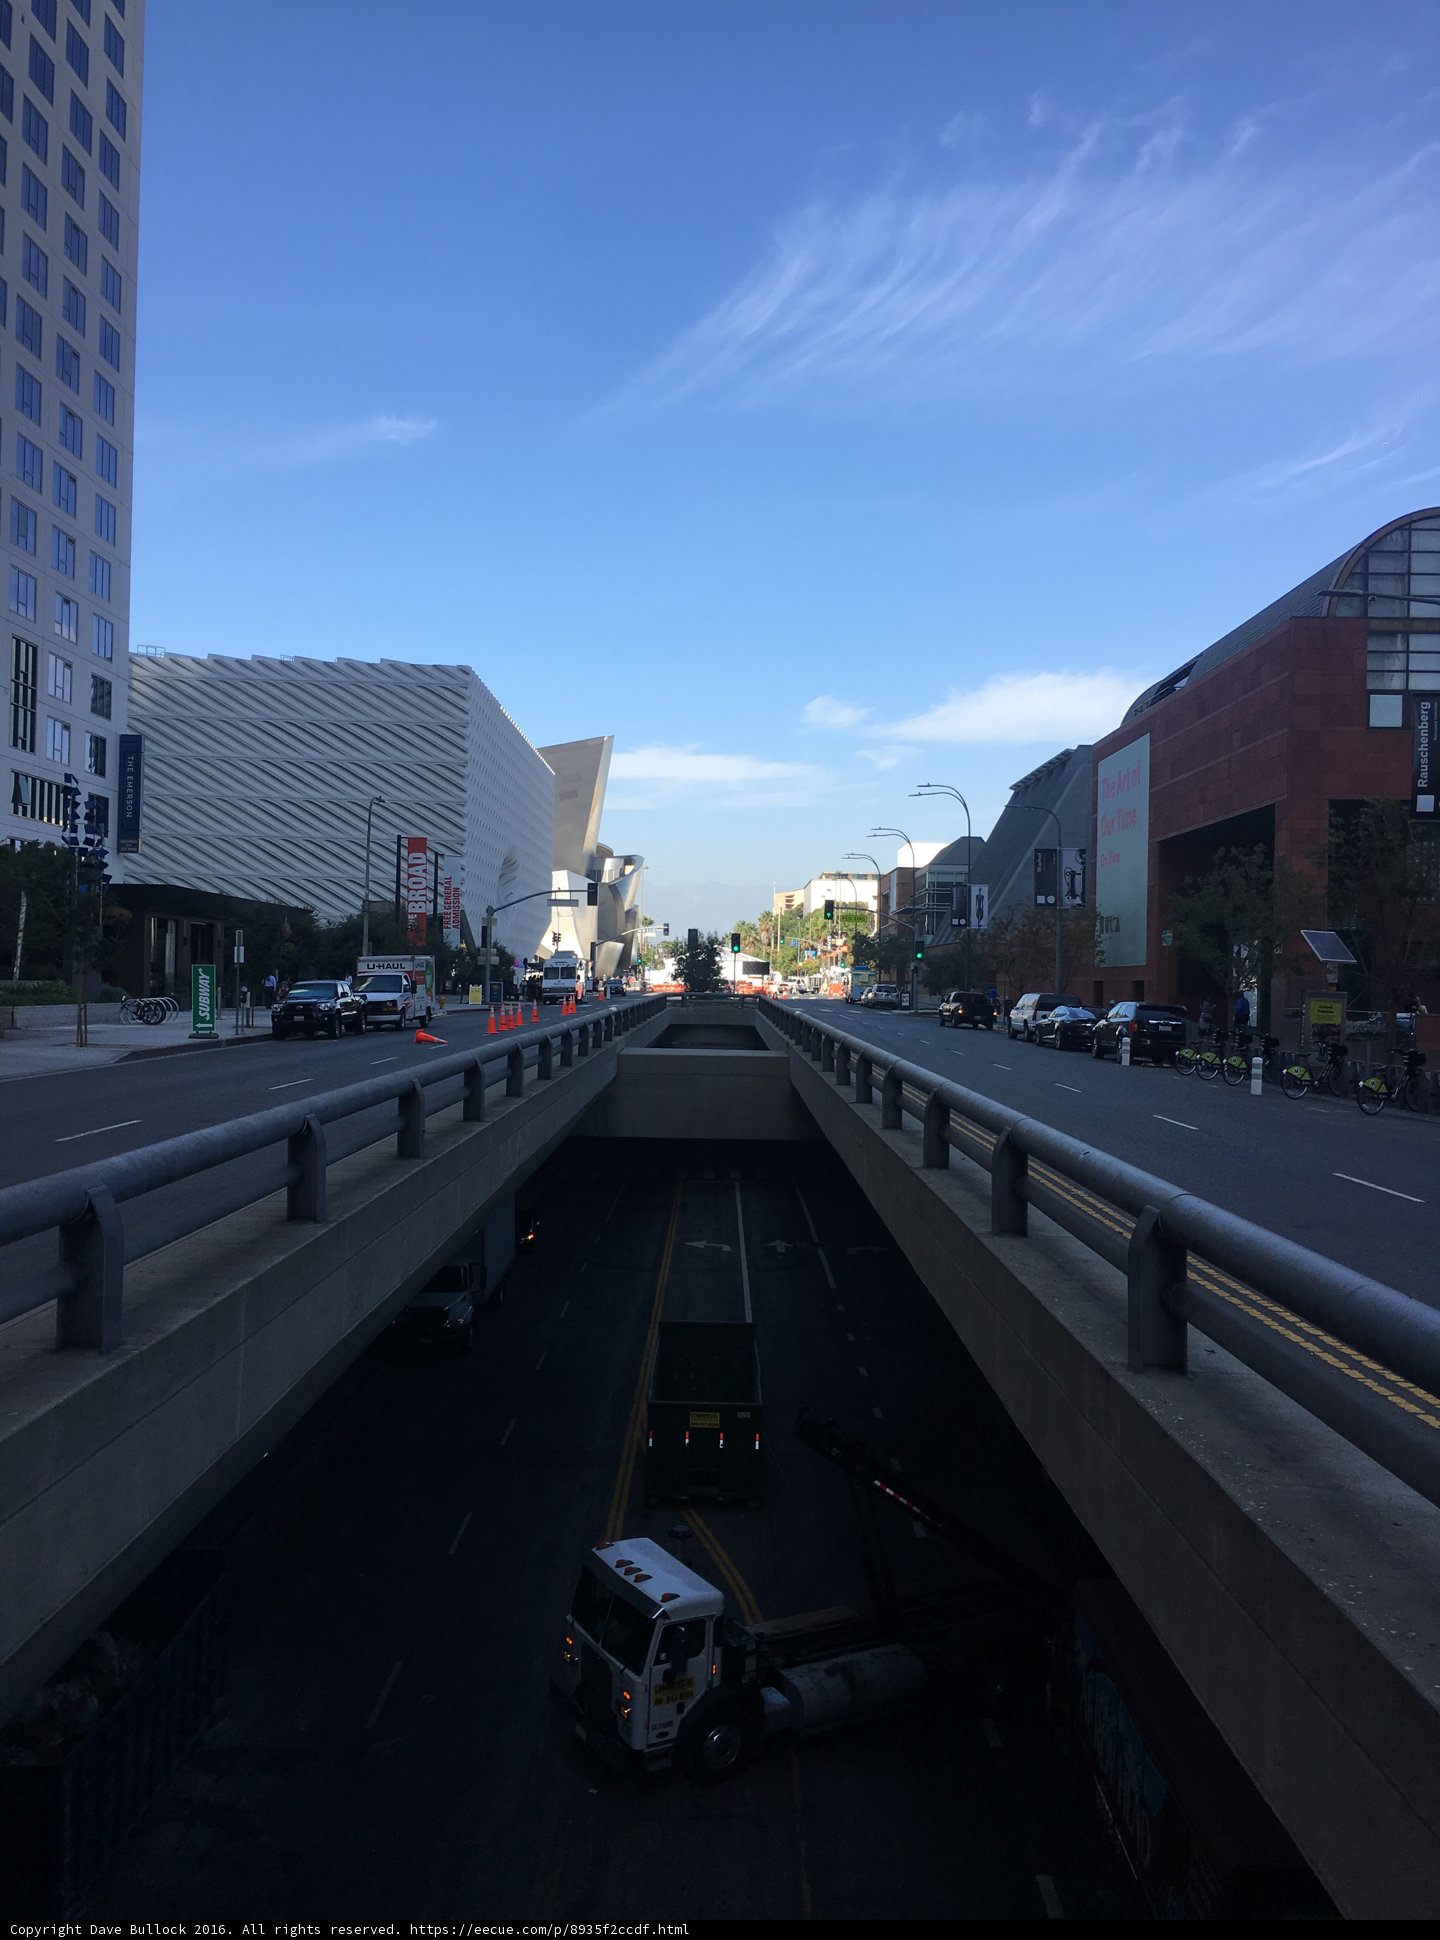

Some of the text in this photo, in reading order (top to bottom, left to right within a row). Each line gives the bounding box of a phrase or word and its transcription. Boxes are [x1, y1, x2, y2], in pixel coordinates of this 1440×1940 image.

[1418, 701, 1431, 788] Rauschenberg
[126, 755, 135, 818] THE EMERSON
[1102, 777, 1115, 801] The
[1117, 768, 1130, 795] Art
[1101, 806, 1137, 838] Our Time
[408, 852, 427, 913] BROAD
[443, 876, 452, 929] FREE GENERAL
[452, 887, 460, 929] ADMISSION
[198, 967, 211, 1021] SUBWAY
